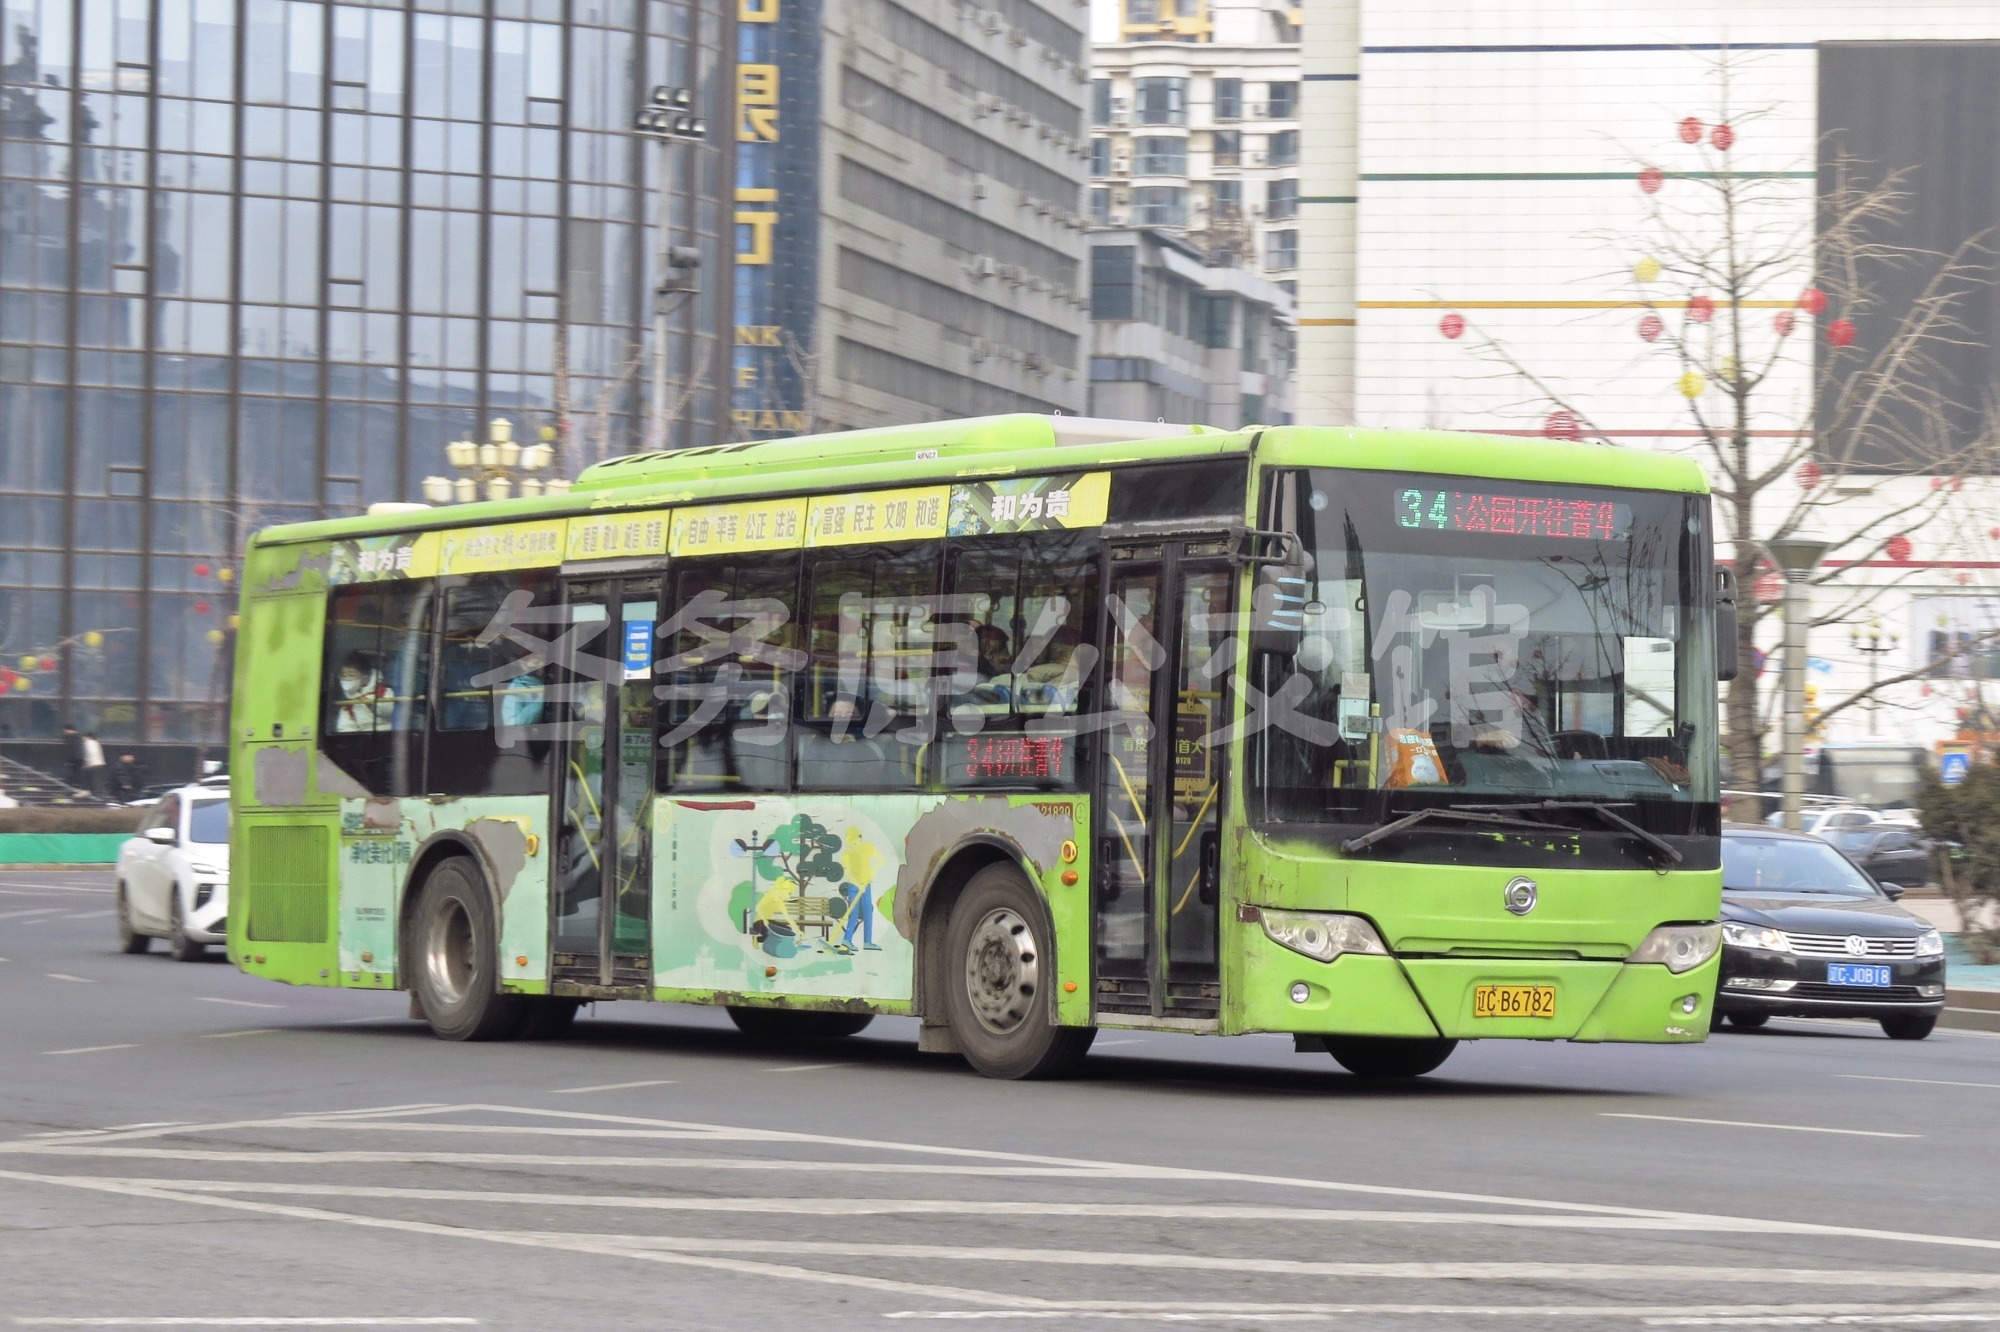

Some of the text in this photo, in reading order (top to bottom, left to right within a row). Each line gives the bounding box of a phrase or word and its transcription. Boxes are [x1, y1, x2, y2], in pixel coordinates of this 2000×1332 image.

[735, 326, 782, 346] NK
[823, 498, 939, 534] 富强 民主 文明 和谐
[991, 490, 1070, 521] 和为贵
[1402, 489, 1447, 529] 34
[688, 510, 796, 544] 自由 平等 公正 法治
[1175, 739, 1204, 754] 首大
